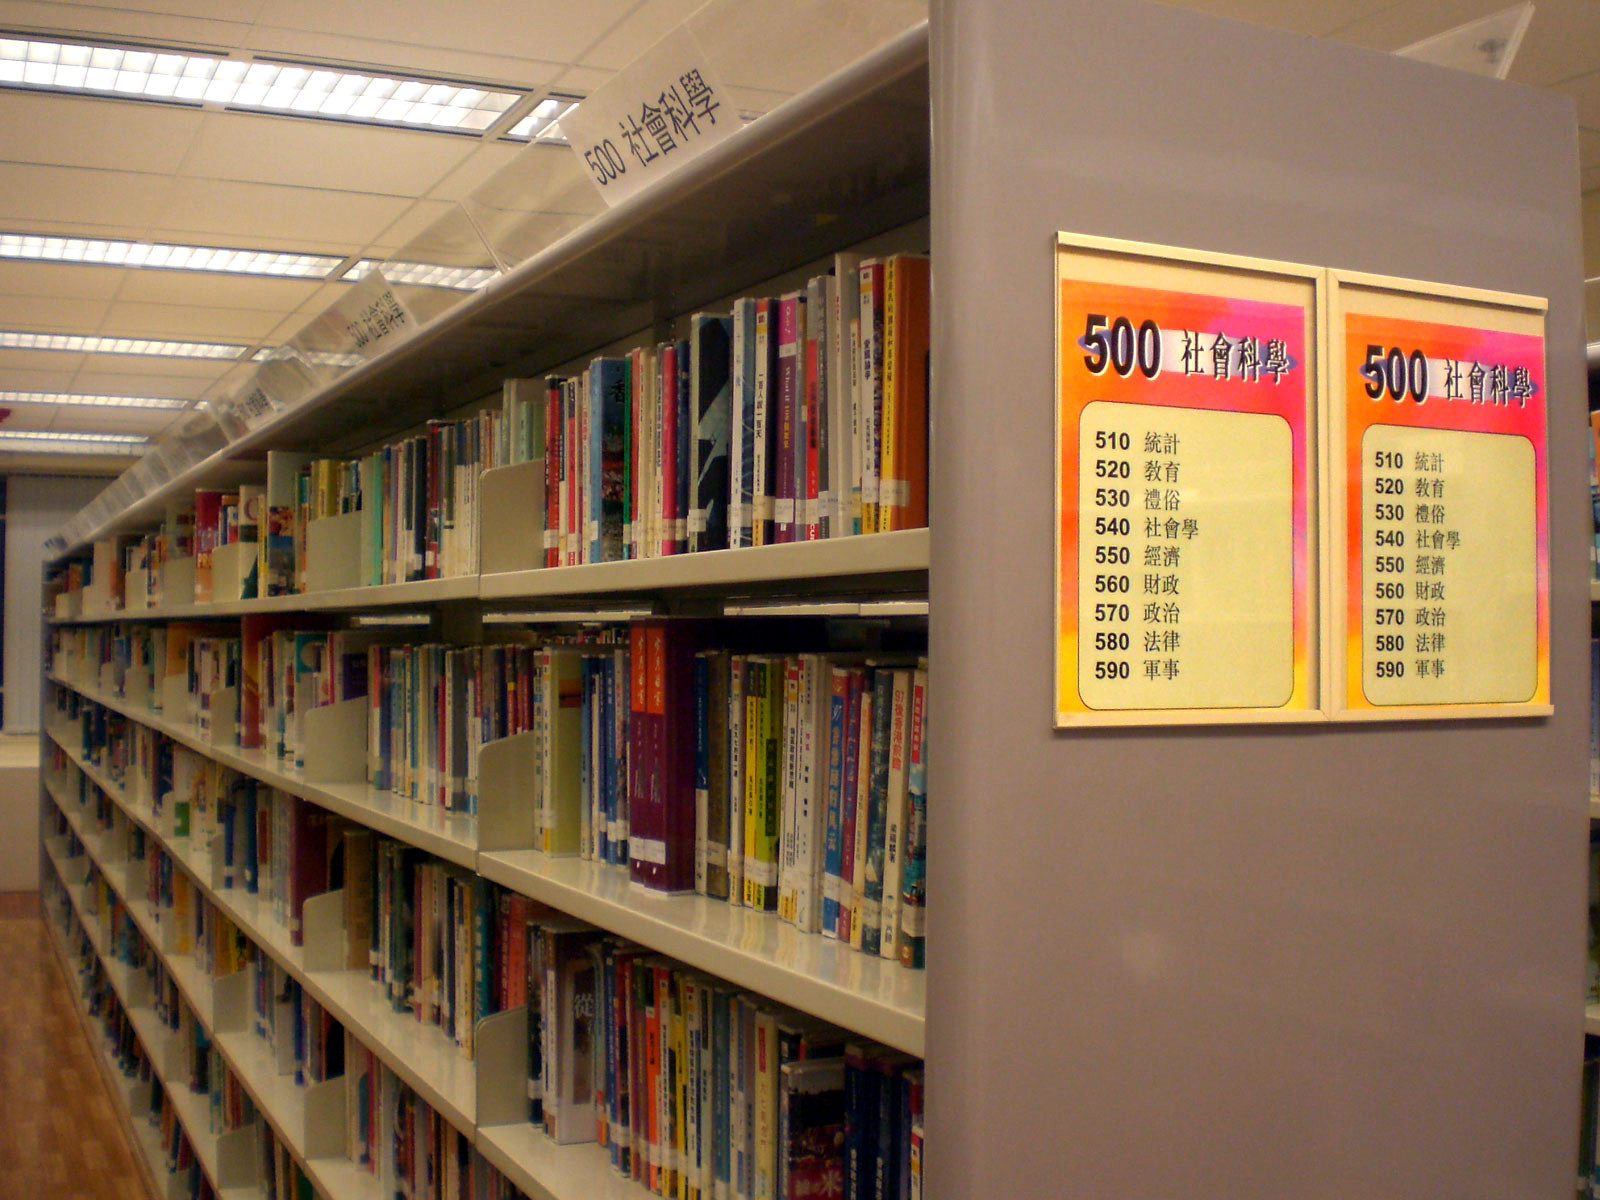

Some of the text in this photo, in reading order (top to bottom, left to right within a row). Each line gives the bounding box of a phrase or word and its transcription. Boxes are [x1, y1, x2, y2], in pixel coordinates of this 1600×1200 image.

[584, 68, 720, 185] 500 社會科學
[1084, 313, 1289, 385] 500 社會科學
[1365, 344, 1533, 408] 500 社會科學
[1095, 431, 1180, 455] 510 統計
[1095, 459, 1130, 479] 520
[1375, 451, 1444, 473] 510 統計
[1375, 477, 1404, 495] 520
[1095, 488, 1180, 511] 530 禮俗
[1375, 503, 1445, 524] 530 禮俗
[1095, 516, 1198, 540] 540 社會學
[1375, 529, 1460, 550] 540 社會學
[1095, 545, 1180, 567] 550 經濟
[1375, 555, 1445, 575] 550 經濟
[1095, 573, 1180, 595] 560 財政
[1375, 581, 1445, 601] 560 財政
[1095, 602, 1180, 624] 570 政治
[1375, 607, 1445, 627] 570 政治
[1095, 630, 1180, 652] 580 法律
[1375, 633, 1446, 653] 580 法律
[1095, 659, 1180, 681] 590 軍事
[1376, 658, 1445, 679] 590 軍事
